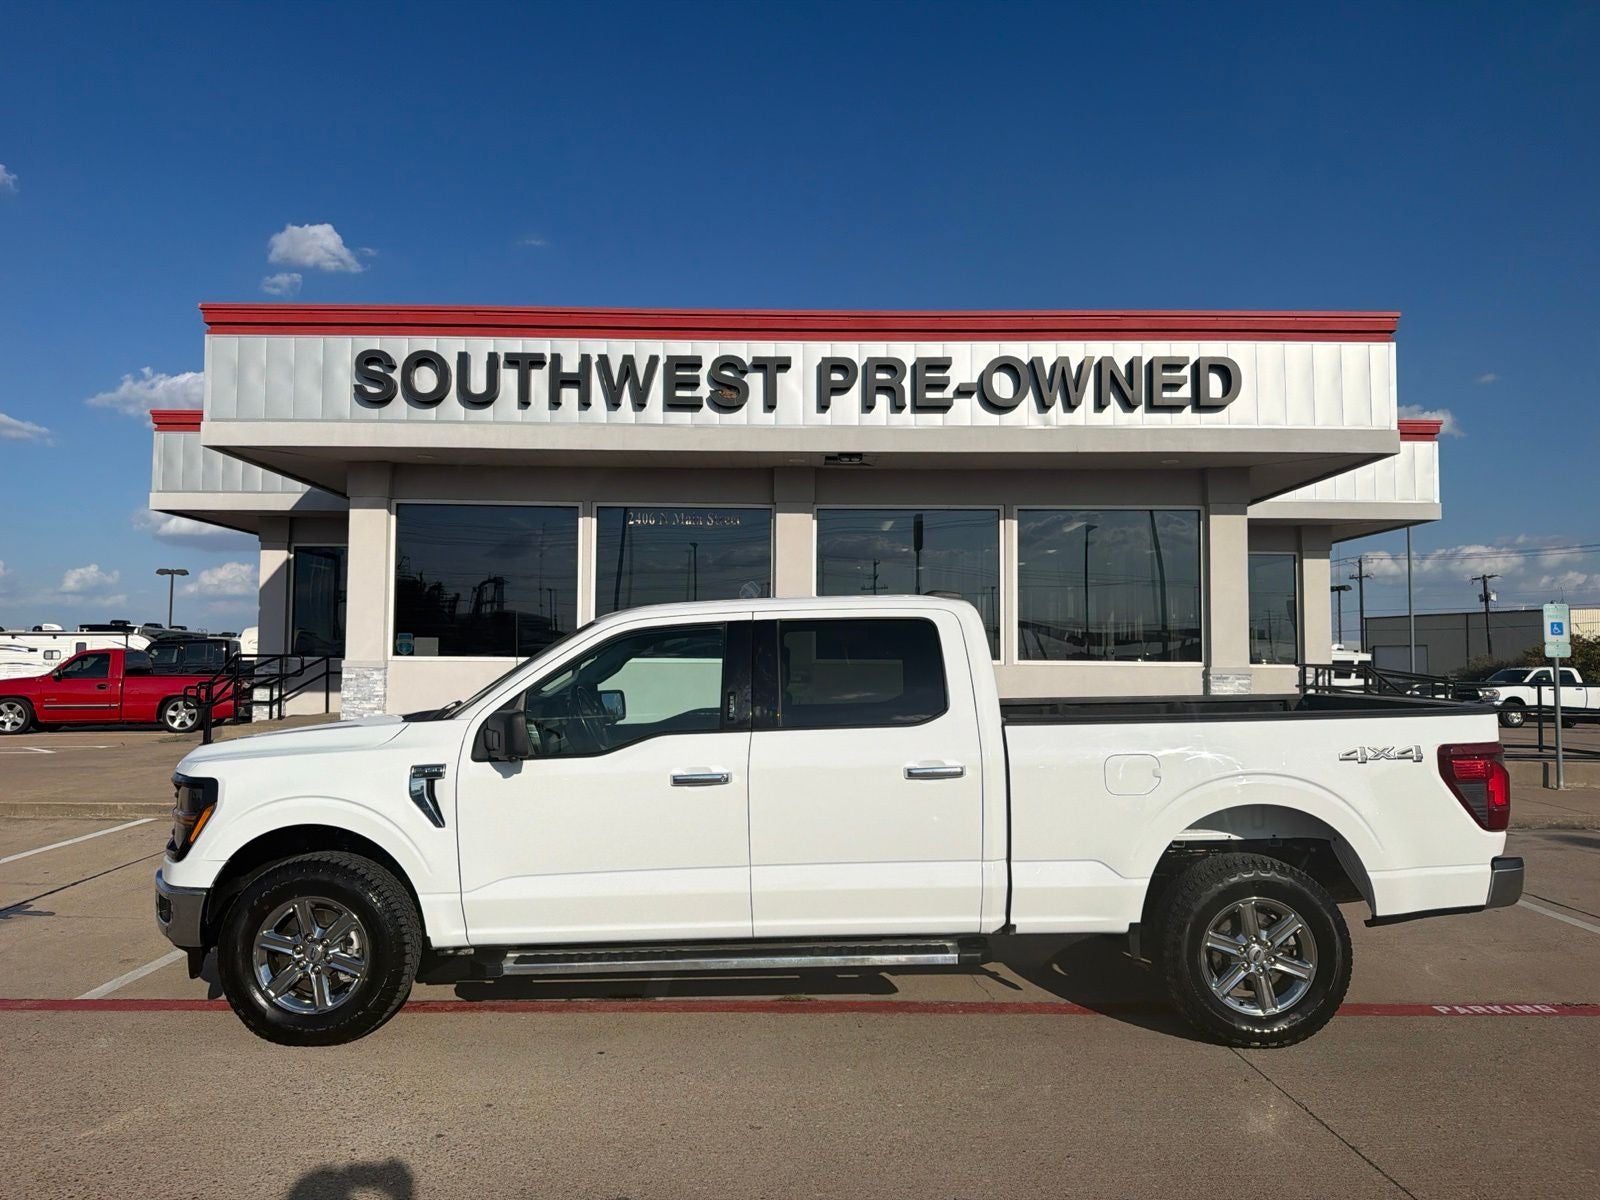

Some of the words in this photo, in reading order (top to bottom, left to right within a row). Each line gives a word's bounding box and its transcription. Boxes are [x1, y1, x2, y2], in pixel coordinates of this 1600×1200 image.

[353, 348, 792, 413] SOUTHWEST
[816, 355, 1242, 414] PRE-OWNED
[628, 511, 655, 525] 2406
[672, 512, 703, 525] Main
